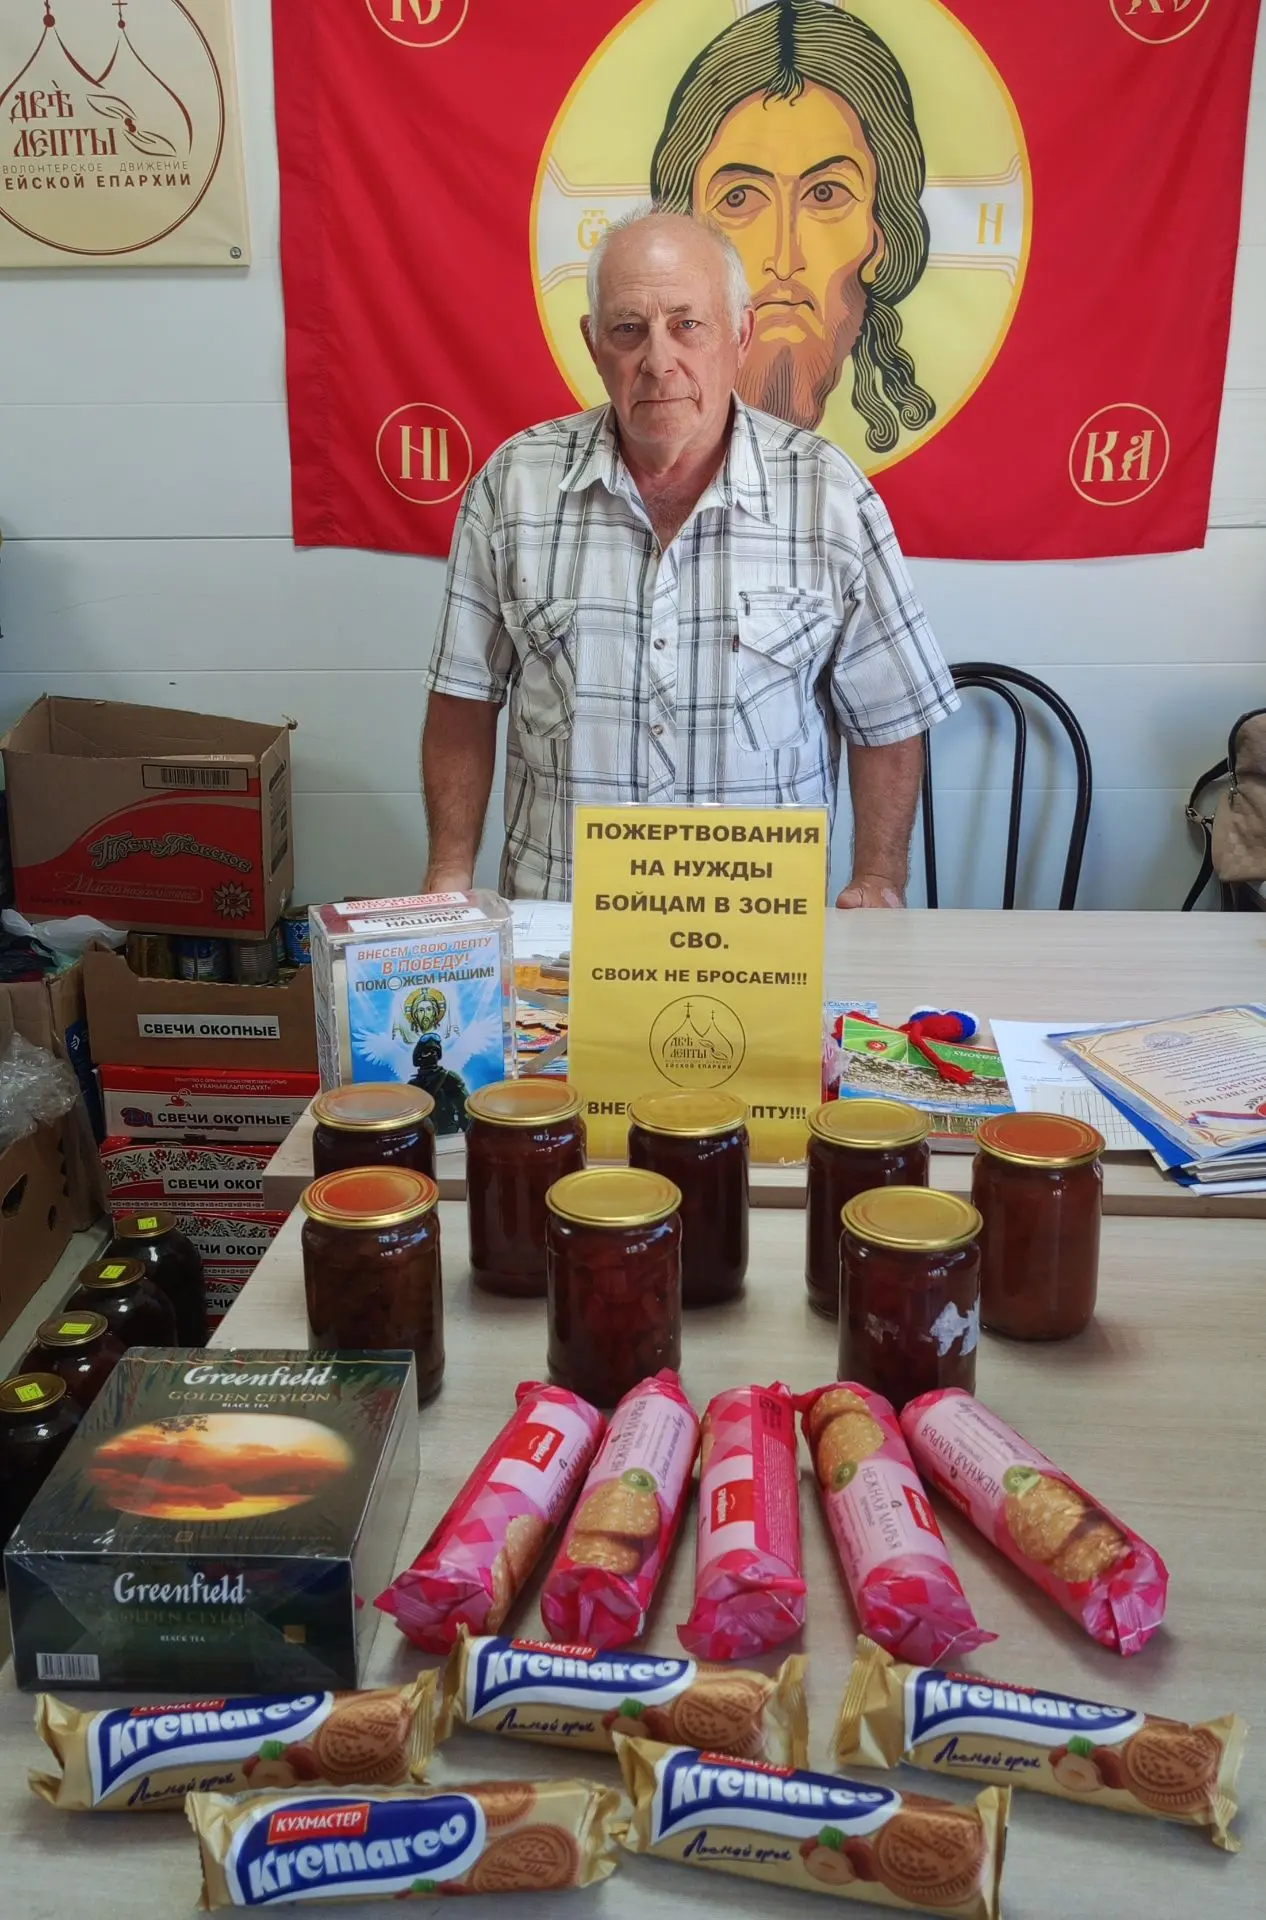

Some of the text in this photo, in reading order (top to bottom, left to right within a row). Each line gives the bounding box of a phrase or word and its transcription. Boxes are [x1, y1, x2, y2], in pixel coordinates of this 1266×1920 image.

[2, 160, 189, 175] ВОЛОНТЕРСКОЕ ДВИЖЕНИЕ
[96, 172, 192, 189] ЕПАРХИИ
[586, 822, 820, 844] ПОЖЕРТВОВАНИЯ
[630, 859, 773, 881] НА НУЖДЫ
[595, 890, 808, 915] БОЙЦАМ В ЗОНЕ
[386, 914, 463, 928] НАШИМ!
[357, 936, 492, 961] ВНЕСЕМ СВОЮ ЛЕПТУ
[669, 931, 730, 950] СВО.
[382, 953, 470, 975] В ПОБЕДУ!
[438, 966, 495, 984] НАШИМ!
[591, 967, 808, 986] СВОИХ НЕ БРОСАЕМ!!!
[143, 1022, 277, 1037] СВЕЧИ ОКОПНЫЕ
[157, 1112, 208, 1124] СВЕЧИ
[212, 1113, 292, 1125] ОКОПНЫЕ
[587, 1101, 807, 1120] ВНЕ ПТУ!!!
[168, 1178, 220, 1190] СВЕЧИ
[225, 1244, 267, 1256] ОКОП
[183, 1365, 333, 1387] Greenfield
[168, 1390, 332, 1403] GOLDEN CEYLON
[921, 1423, 957, 1460] МАРЬЯ
[955, 1450, 1001, 1499] НЕЖНАЯ
[861, 1465, 889, 1512] НЕЖНАЯ
[113, 1571, 247, 1605] Greenfield
[160, 1634, 206, 1643] BLACK TEA
[276, 1811, 362, 1833] КУХМАСТЕР
